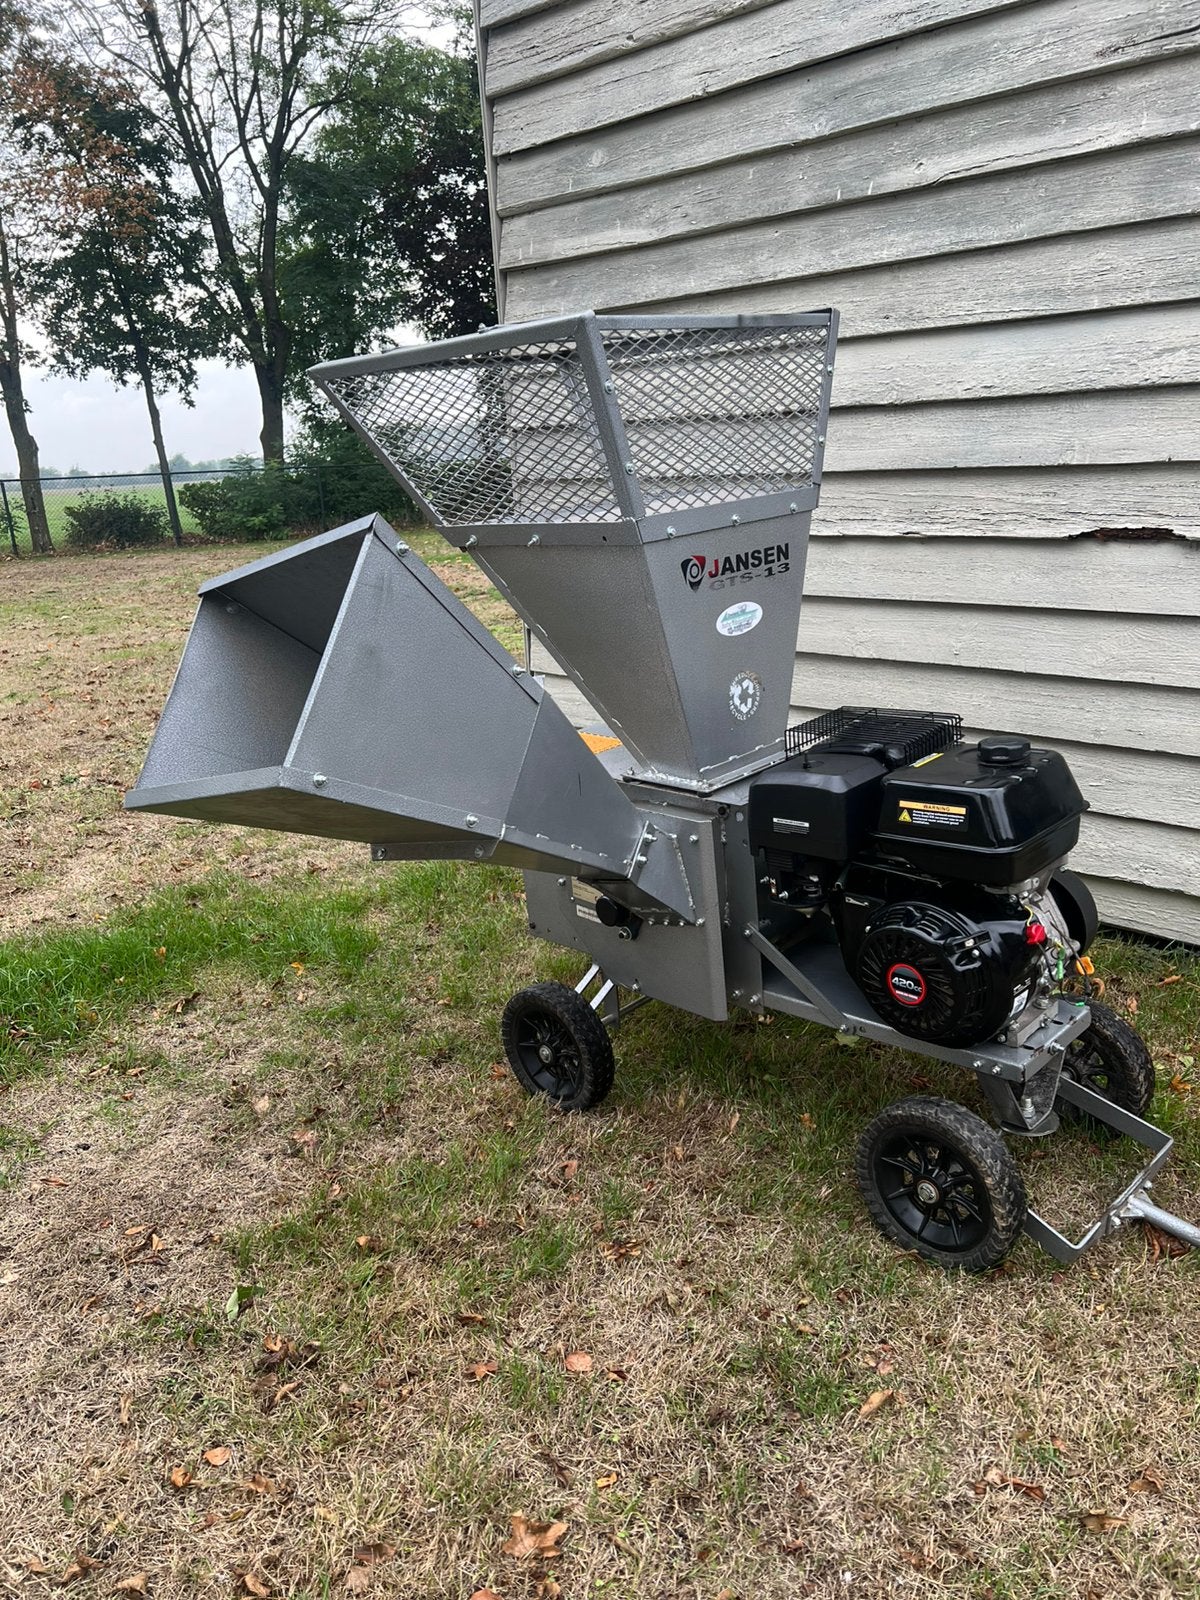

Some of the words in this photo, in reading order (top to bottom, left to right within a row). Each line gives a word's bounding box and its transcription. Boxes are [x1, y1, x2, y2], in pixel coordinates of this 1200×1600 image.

[708, 543, 789, 578] JANSEN
[709, 562, 790, 591] GTS-13
[923, 804, 951, 812] WARNING
[891, 976, 922, 993] 420cc
